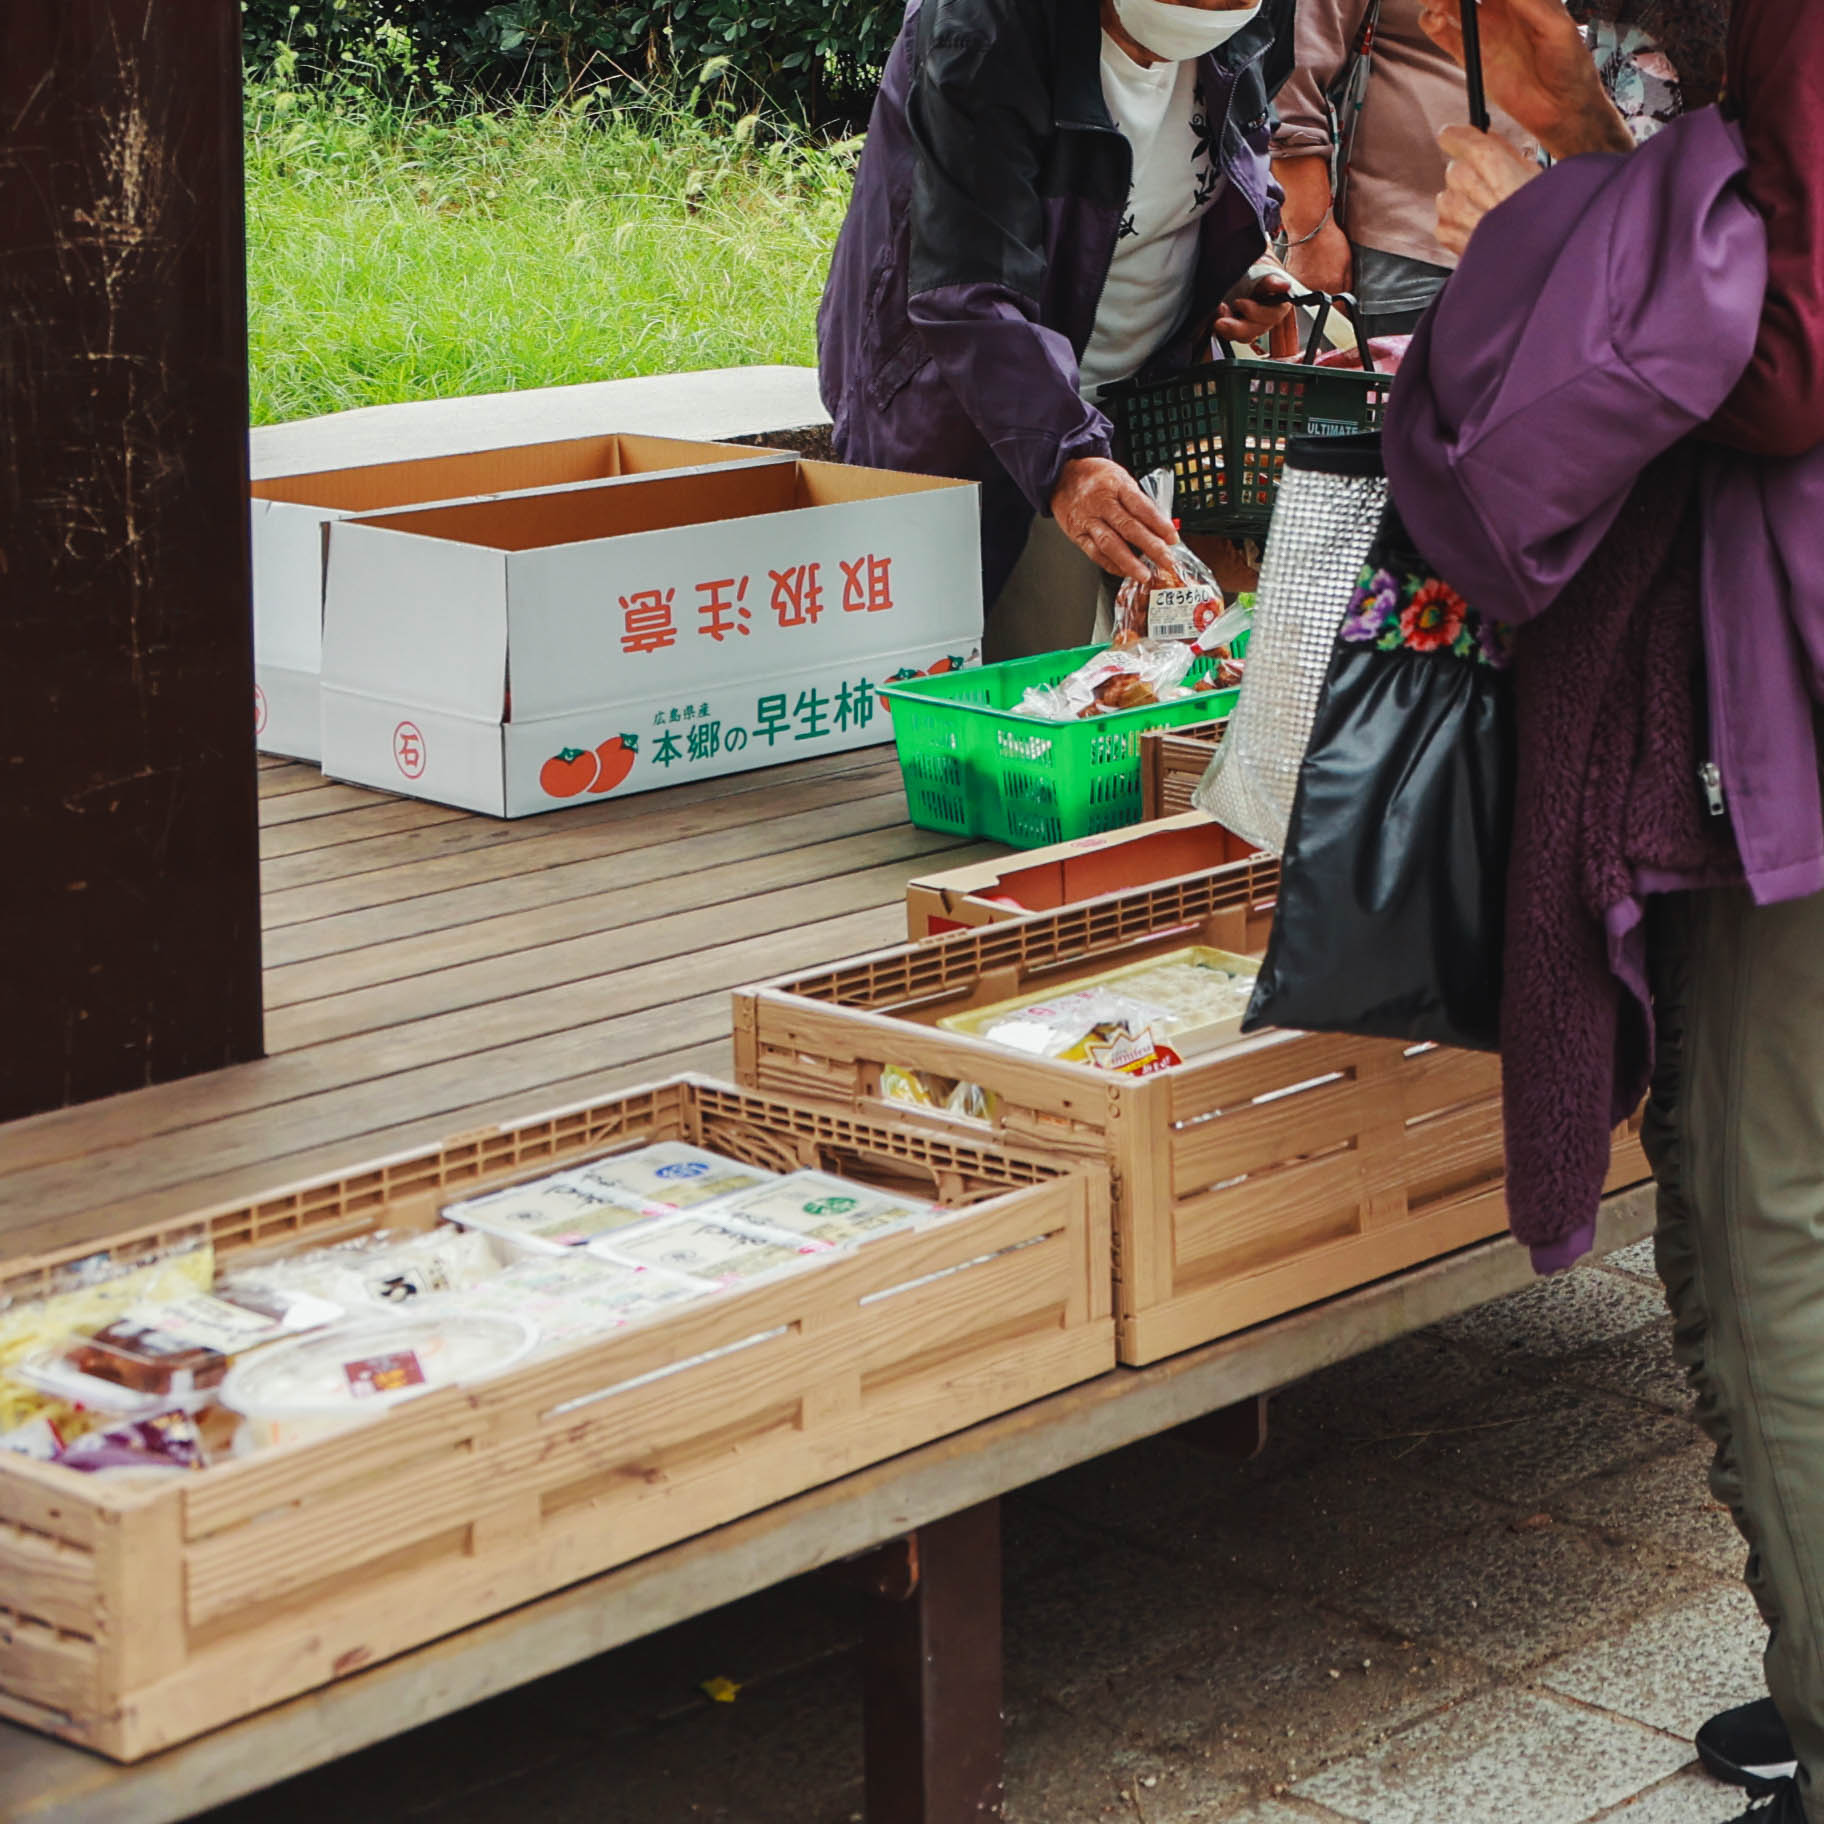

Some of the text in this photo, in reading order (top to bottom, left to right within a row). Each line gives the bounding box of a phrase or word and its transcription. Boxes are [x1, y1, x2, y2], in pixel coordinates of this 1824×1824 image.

[1307, 422, 1359, 436] ULTIMATE
[617, 553, 894, 654] 取扱注意
[651, 677, 875, 768] 本郷の早生柿
[653, 702, 711, 726] 広島県産
